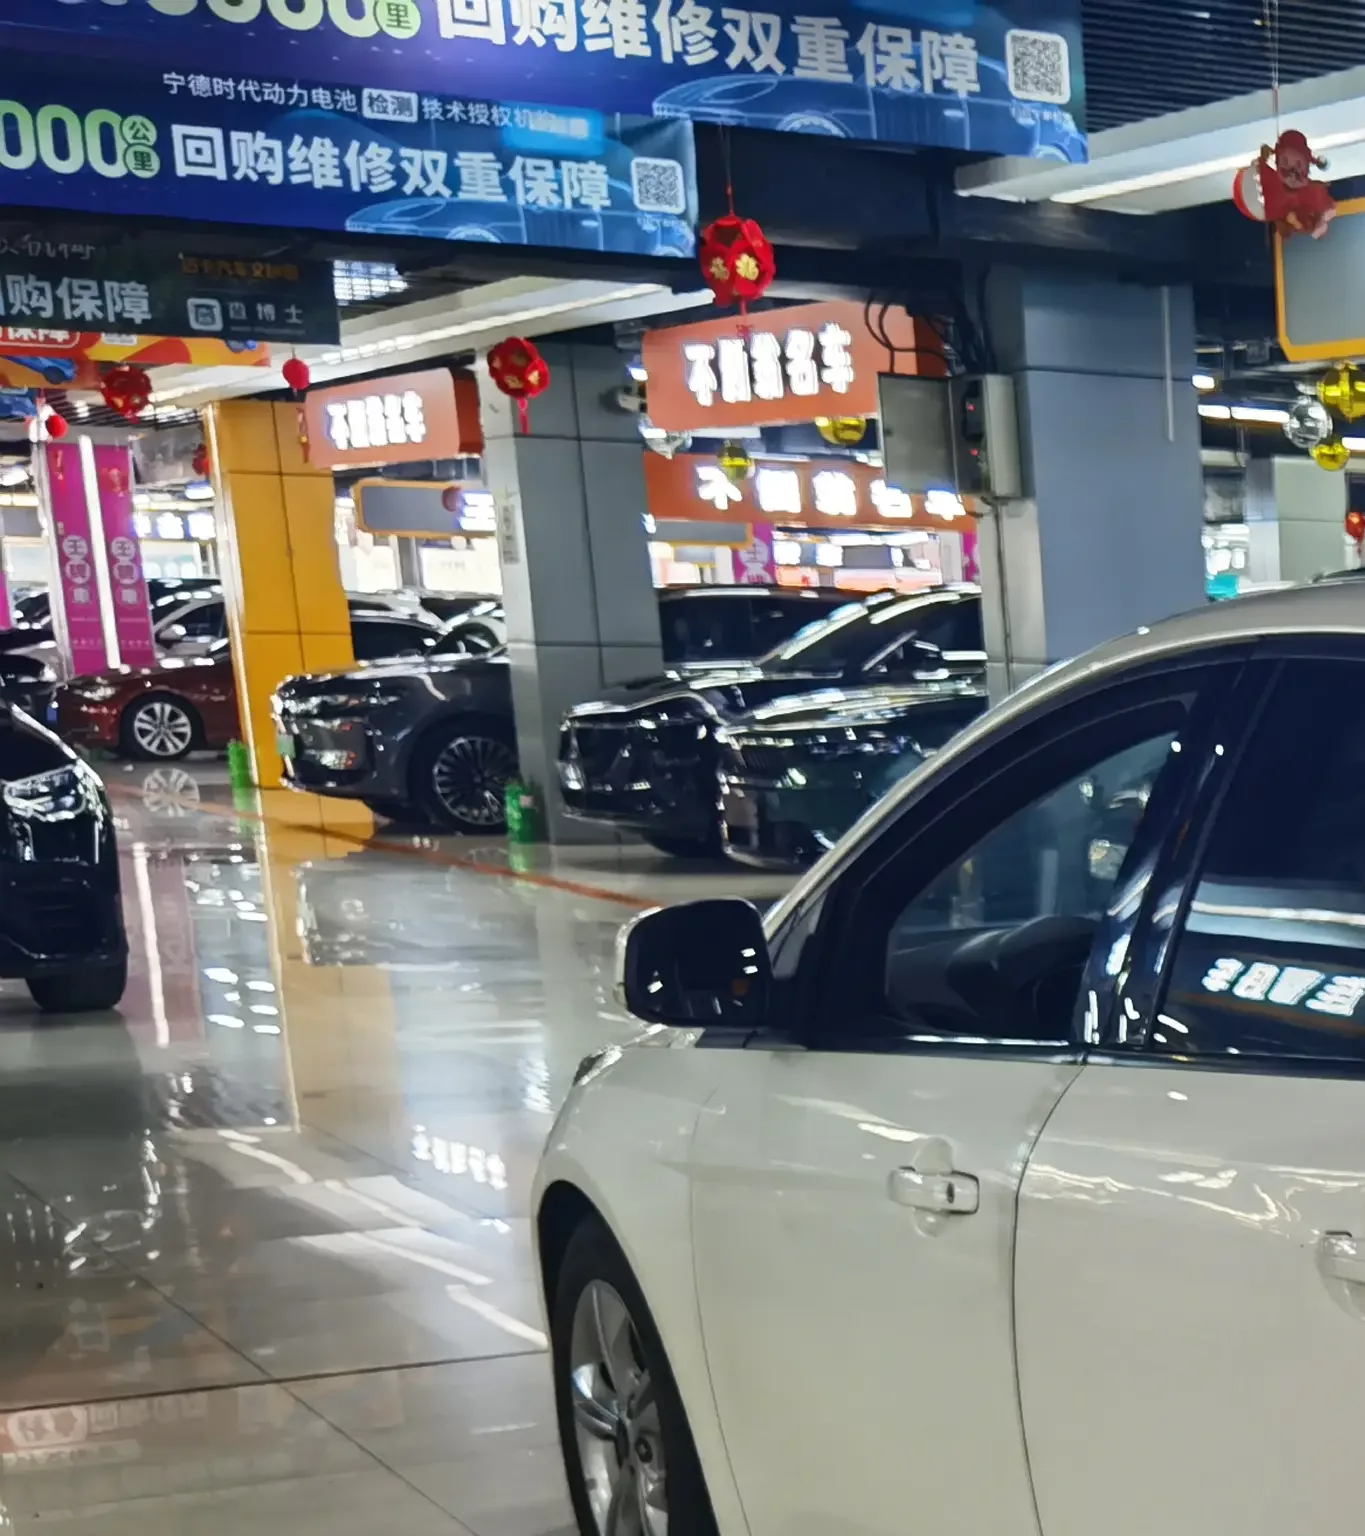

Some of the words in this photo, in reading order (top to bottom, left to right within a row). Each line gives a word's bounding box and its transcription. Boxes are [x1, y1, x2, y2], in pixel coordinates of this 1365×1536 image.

[437, 0, 981, 97] 回购维修双重保障
[172, 124, 611, 212] 回购维修双重保障
[0, 274, 152, 325] 购保障
